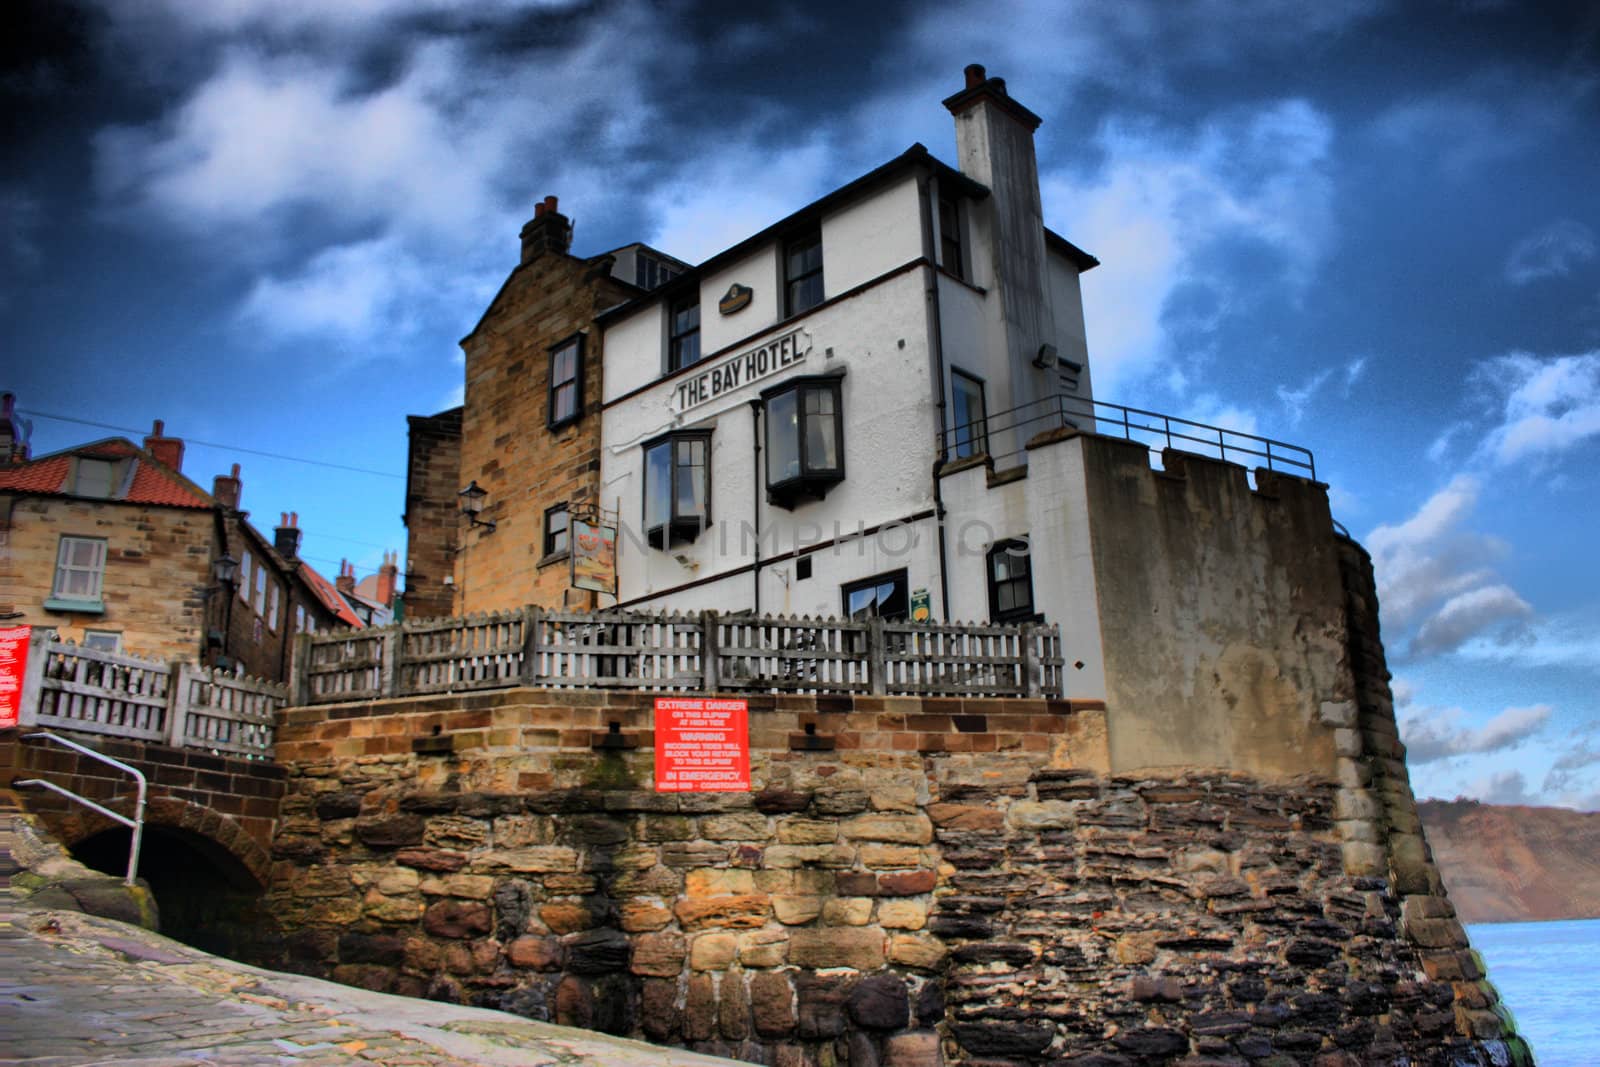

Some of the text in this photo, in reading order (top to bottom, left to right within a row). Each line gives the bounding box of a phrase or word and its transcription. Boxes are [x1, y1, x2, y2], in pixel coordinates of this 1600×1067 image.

[678, 333, 804, 410] THE BAY HOTEL
[657, 701, 746, 711] EXTREME DANGER
[680, 732, 726, 741] WARNING
[665, 771, 740, 780] IN EMERGENCY
